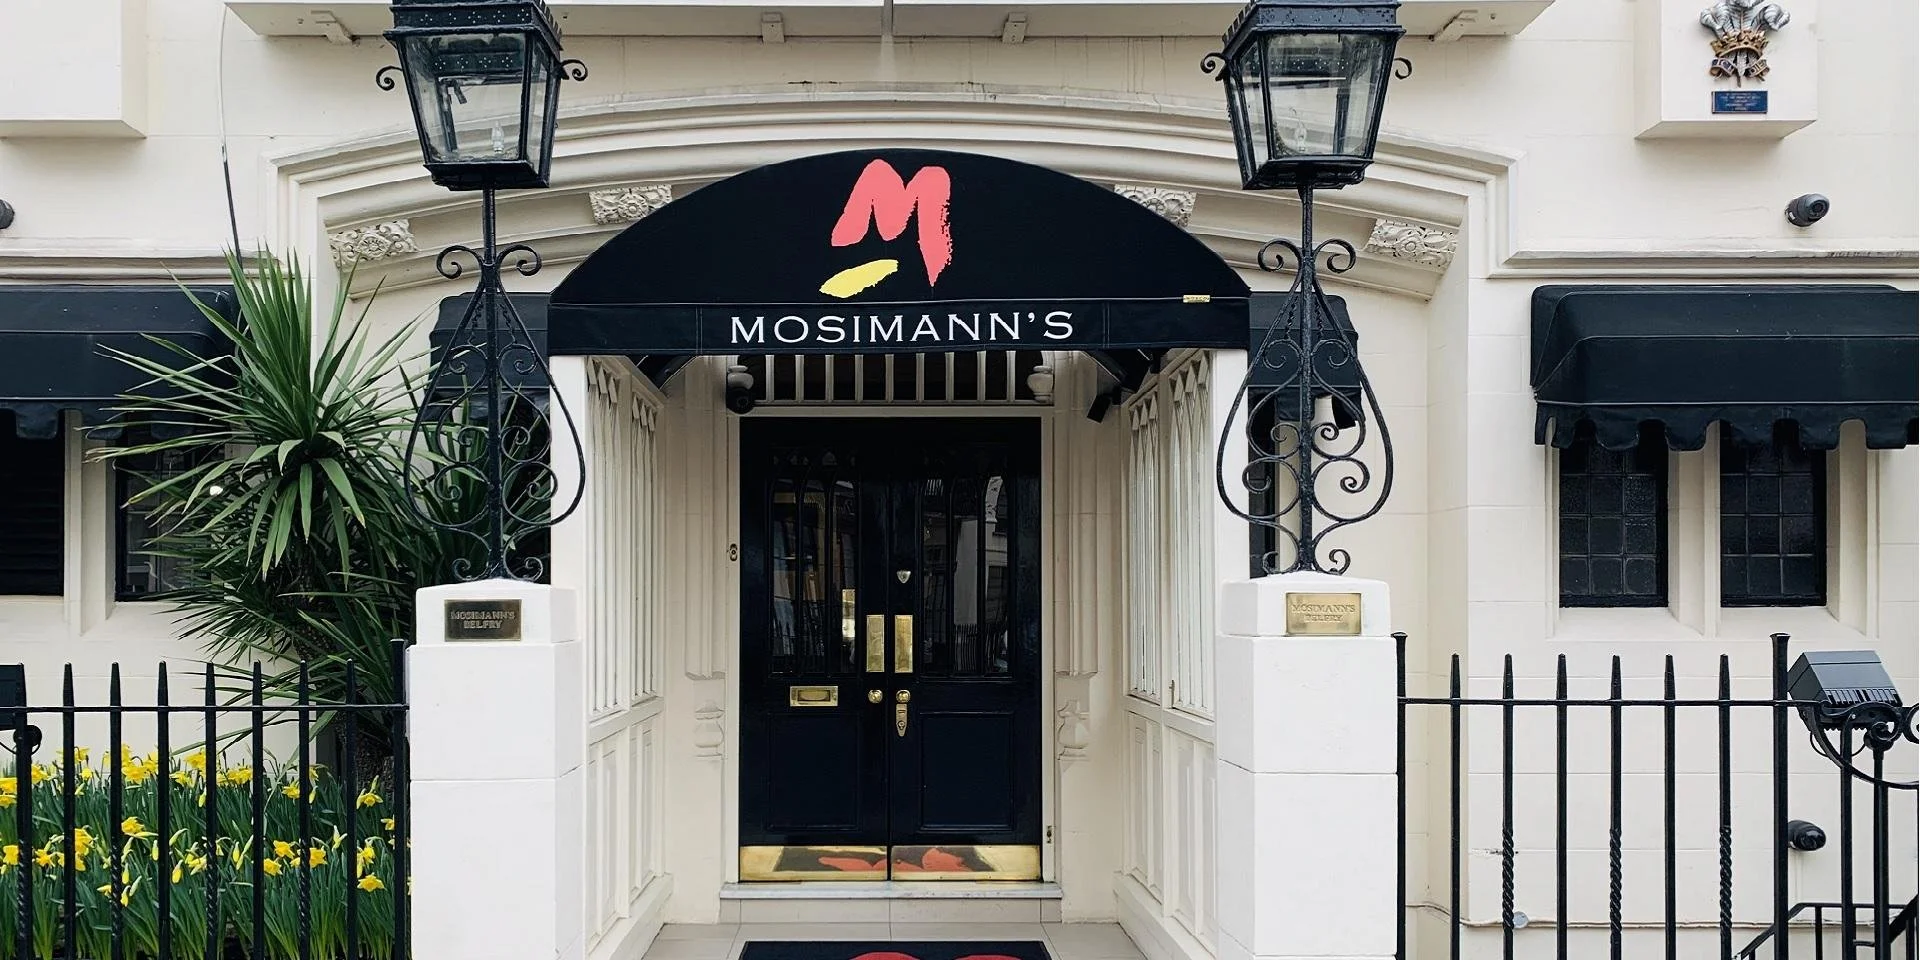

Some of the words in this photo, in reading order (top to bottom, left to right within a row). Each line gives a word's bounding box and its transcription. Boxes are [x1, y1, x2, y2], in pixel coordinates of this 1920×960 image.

[731, 311, 1074, 344] MOSIMANN'S
[1291, 604, 1356, 613] MOSIMANN'S
[450, 611, 516, 620] MOSIMANN'S
[463, 620, 503, 629] BELFRY
